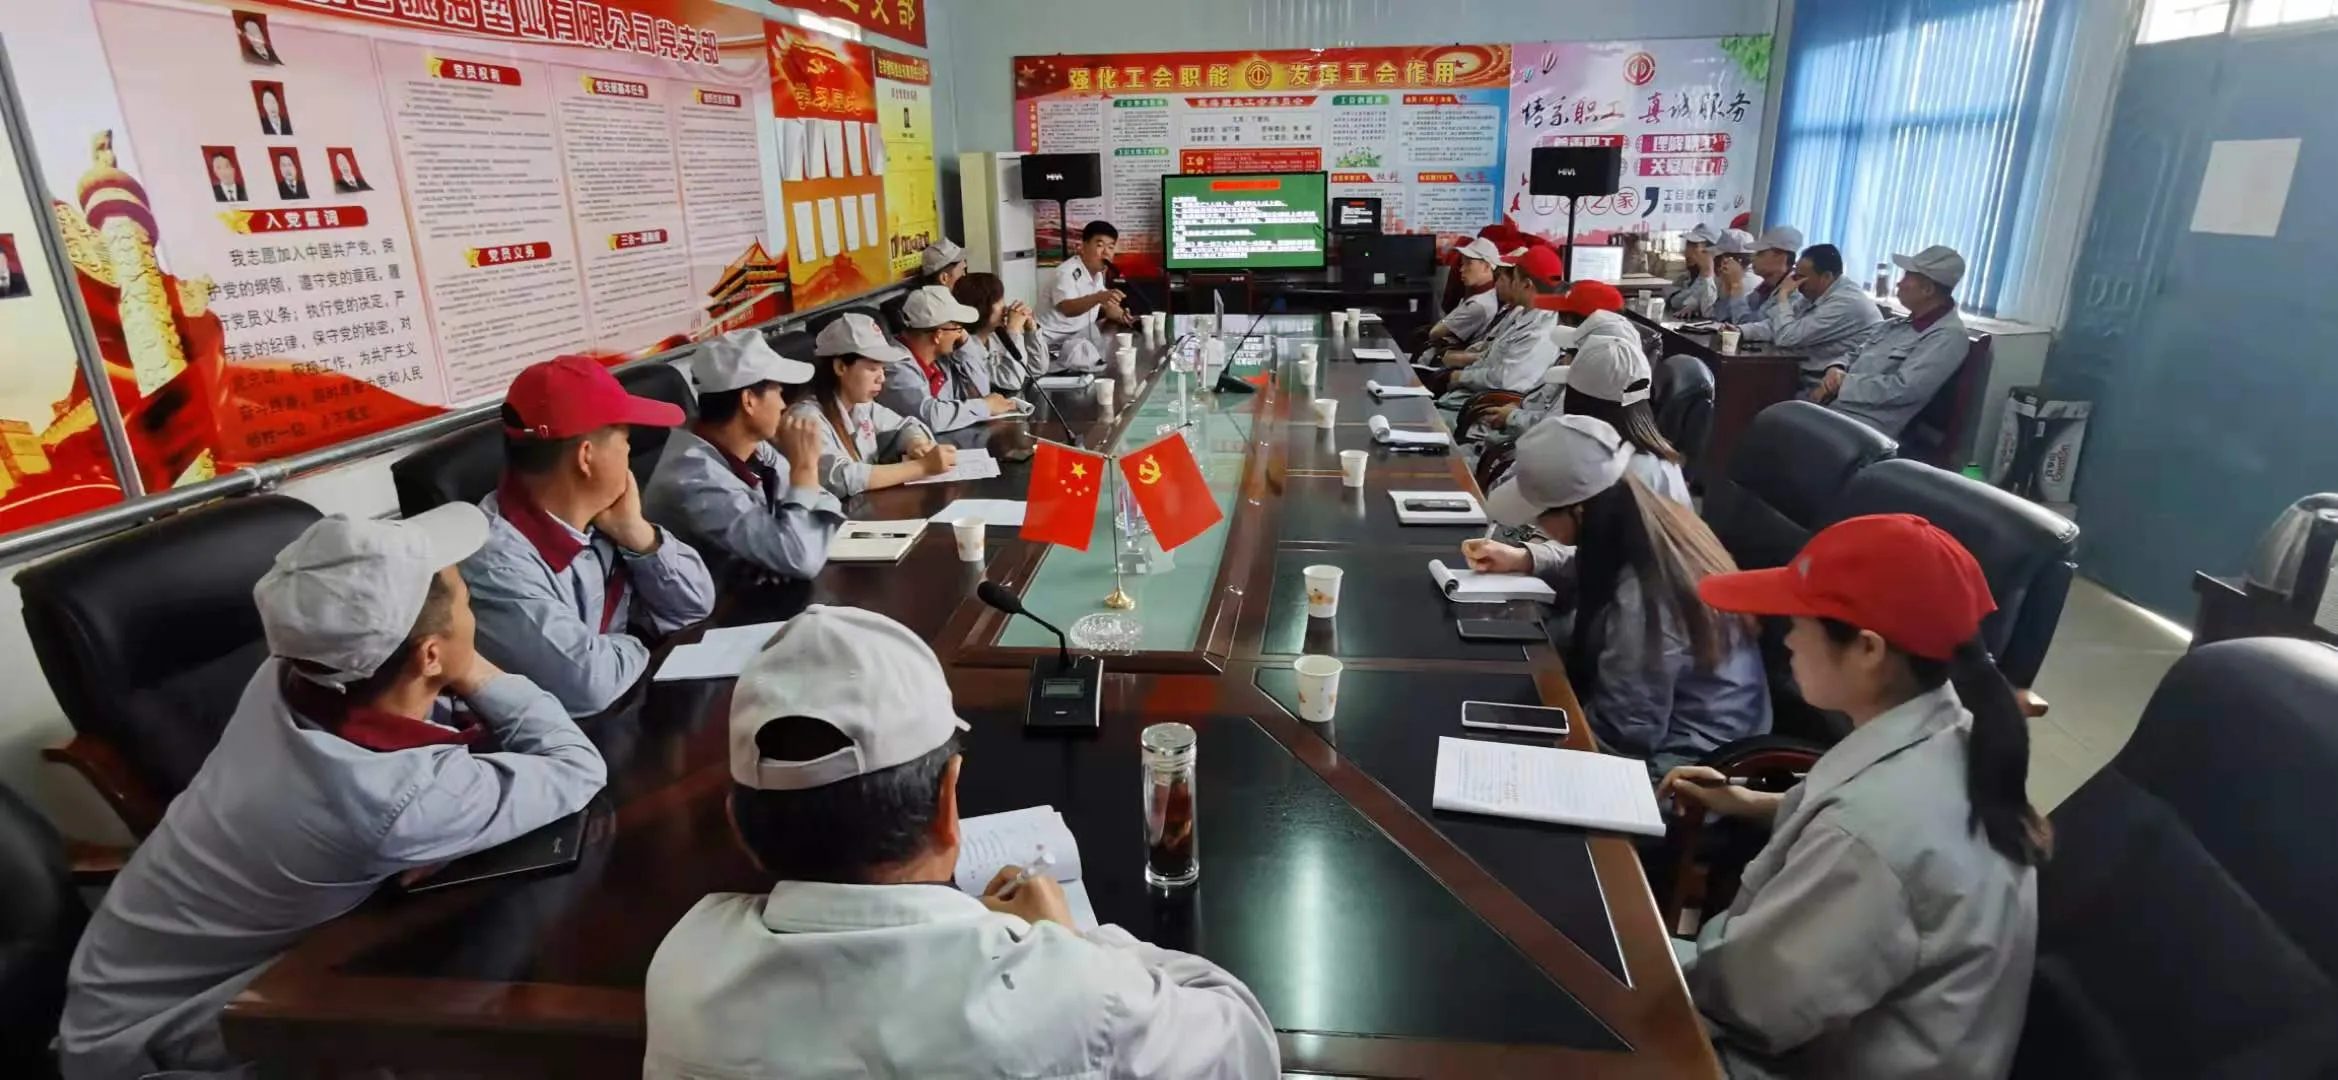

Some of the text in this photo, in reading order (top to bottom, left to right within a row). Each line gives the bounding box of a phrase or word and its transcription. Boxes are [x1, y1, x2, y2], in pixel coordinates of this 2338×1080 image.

[453, 63, 500, 81] 党员权利
[1069, 60, 1456, 91] 强化工会职能 发挥工会作用
[1522, 91, 1752, 128] 情系职工 真诚服务
[265, 210, 340, 229] 入党誓词
[487, 245, 536, 262] 党员义务
